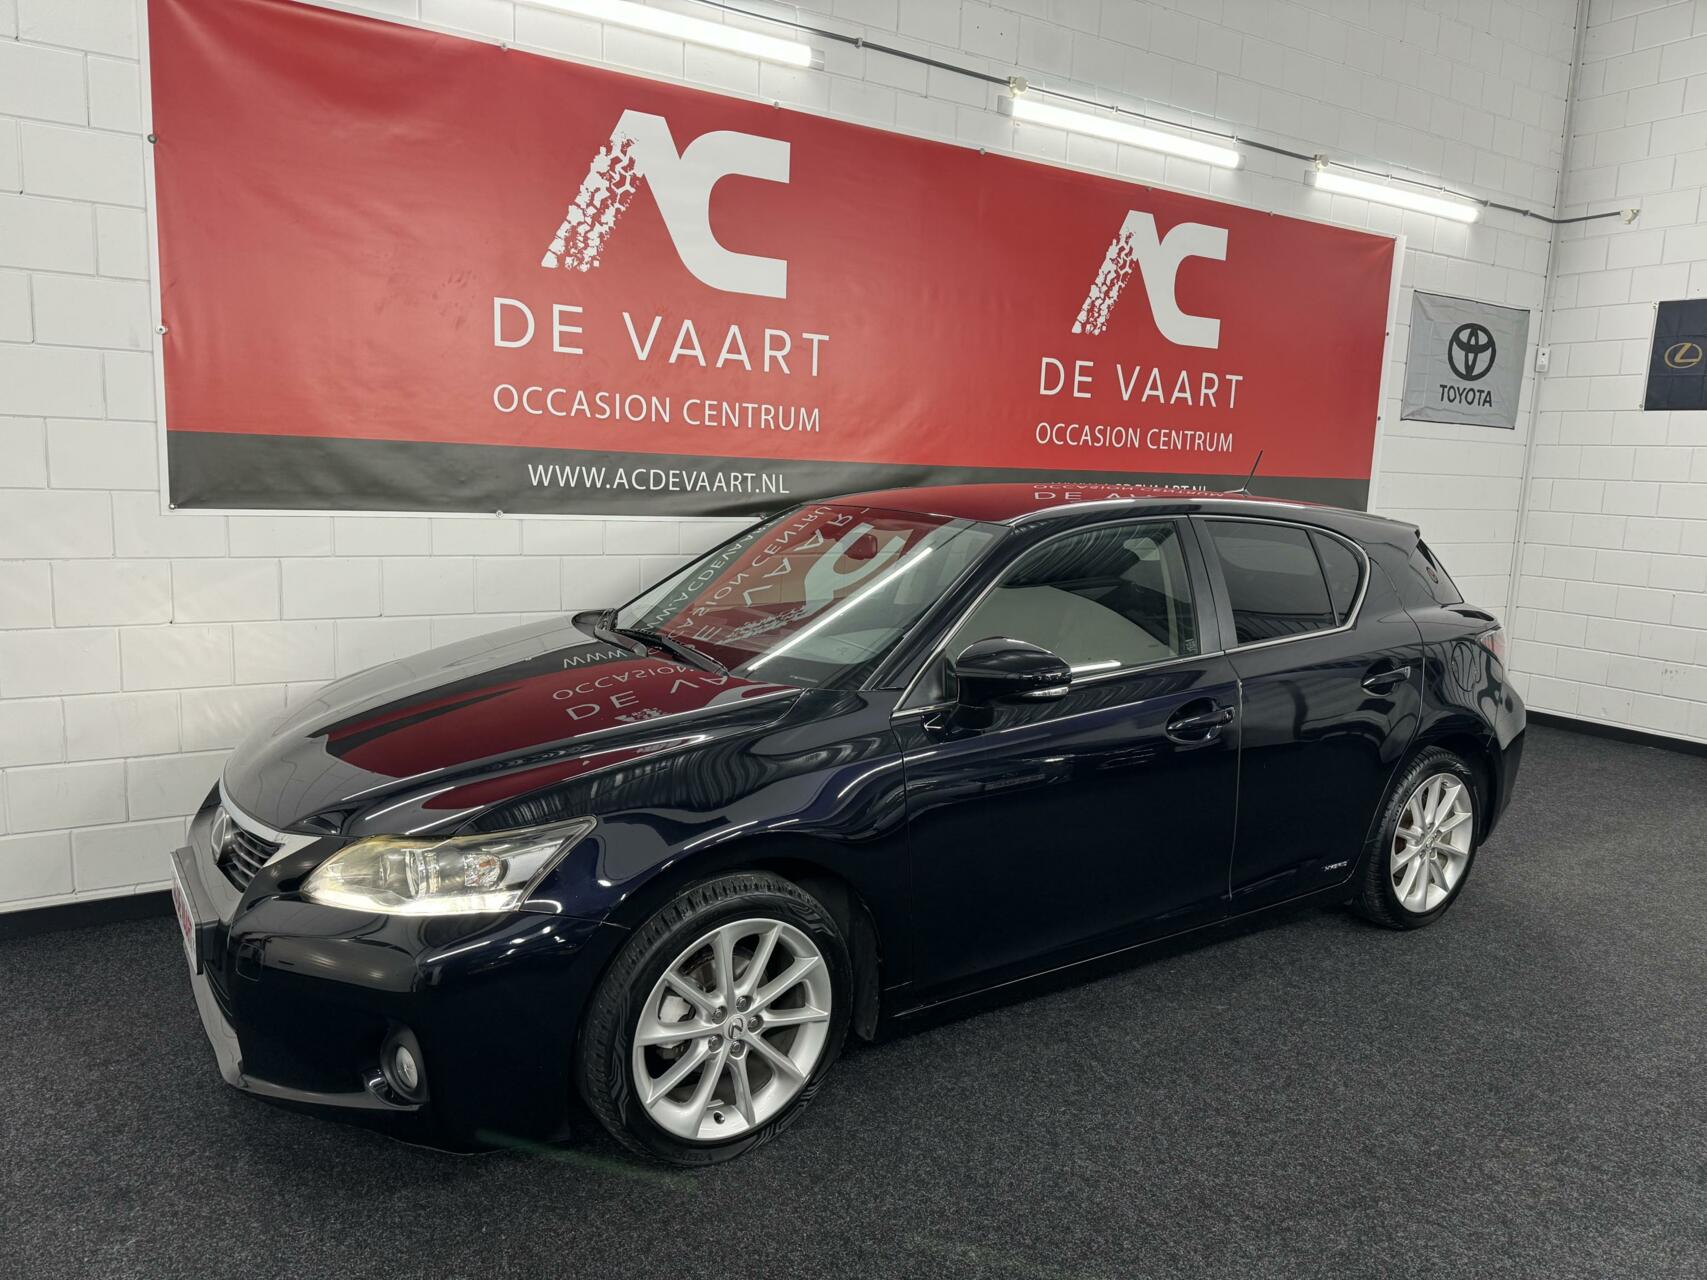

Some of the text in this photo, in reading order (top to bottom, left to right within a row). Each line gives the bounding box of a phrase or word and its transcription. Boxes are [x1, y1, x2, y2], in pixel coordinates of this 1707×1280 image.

[541, 109, 791, 300] AC
[1071, 209, 1229, 350] AC
[493, 296, 830, 377] DE VAART
[1039, 356, 1243, 409] DE VAART
[1439, 384, 1493, 408] TOYOTA
[493, 384, 821, 432] OCCASION CENTRUM
[1035, 422, 1233, 452] OCCASION CENTRUM
[527, 464, 790, 494] WWW.ACDEVAART.NL
